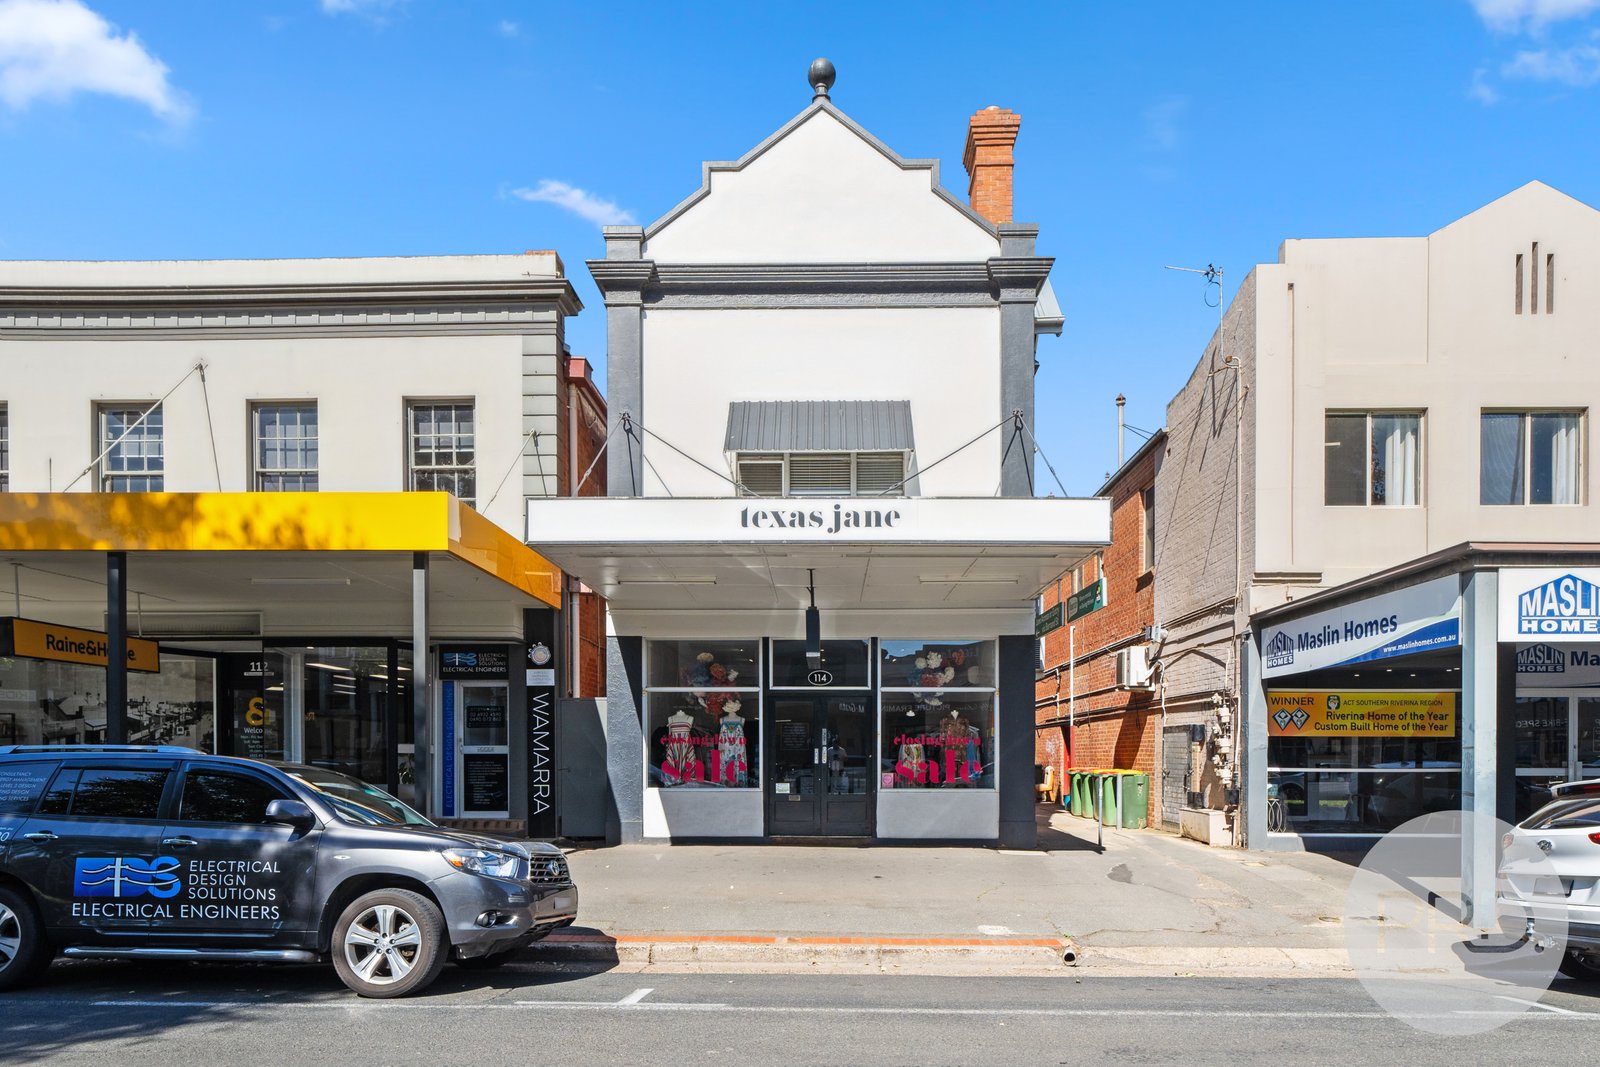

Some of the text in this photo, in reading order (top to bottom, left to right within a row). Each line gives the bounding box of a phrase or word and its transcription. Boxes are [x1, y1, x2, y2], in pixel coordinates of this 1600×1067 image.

[740, 503, 900, 534] texas jane
[1521, 578, 1600, 617] MASLI
[1298, 614, 1397, 652] Maslin Homes
[1521, 620, 1600, 632] HOME
[1266, 631, 1294, 658] MASLIN
[1383, 634, 1457, 653] www.maslinhomes.com.au
[1267, 656, 1293, 668] HOMES
[1517, 644, 1600, 666] MASLIN Ma
[814, 673, 827, 682] 114
[1270, 697, 1315, 705] WINNER
[1326, 711, 1449, 720] Riverina Home of the Year
[1314, 722, 1449, 731] Custom Built Home of the Year
[660, 733, 709, 747] closing
[893, 734, 944, 747] closing
[533, 692, 550, 815] WAMARRA
[661, 749, 748, 783] sale
[895, 749, 982, 784] sale
[189, 860, 281, 873] ELECTRICAL
[188, 874, 247, 886] DESIGN
[188, 887, 277, 900] SOLUTIONS
[72, 903, 280, 920] ELECTRICAL ENGINEERS
